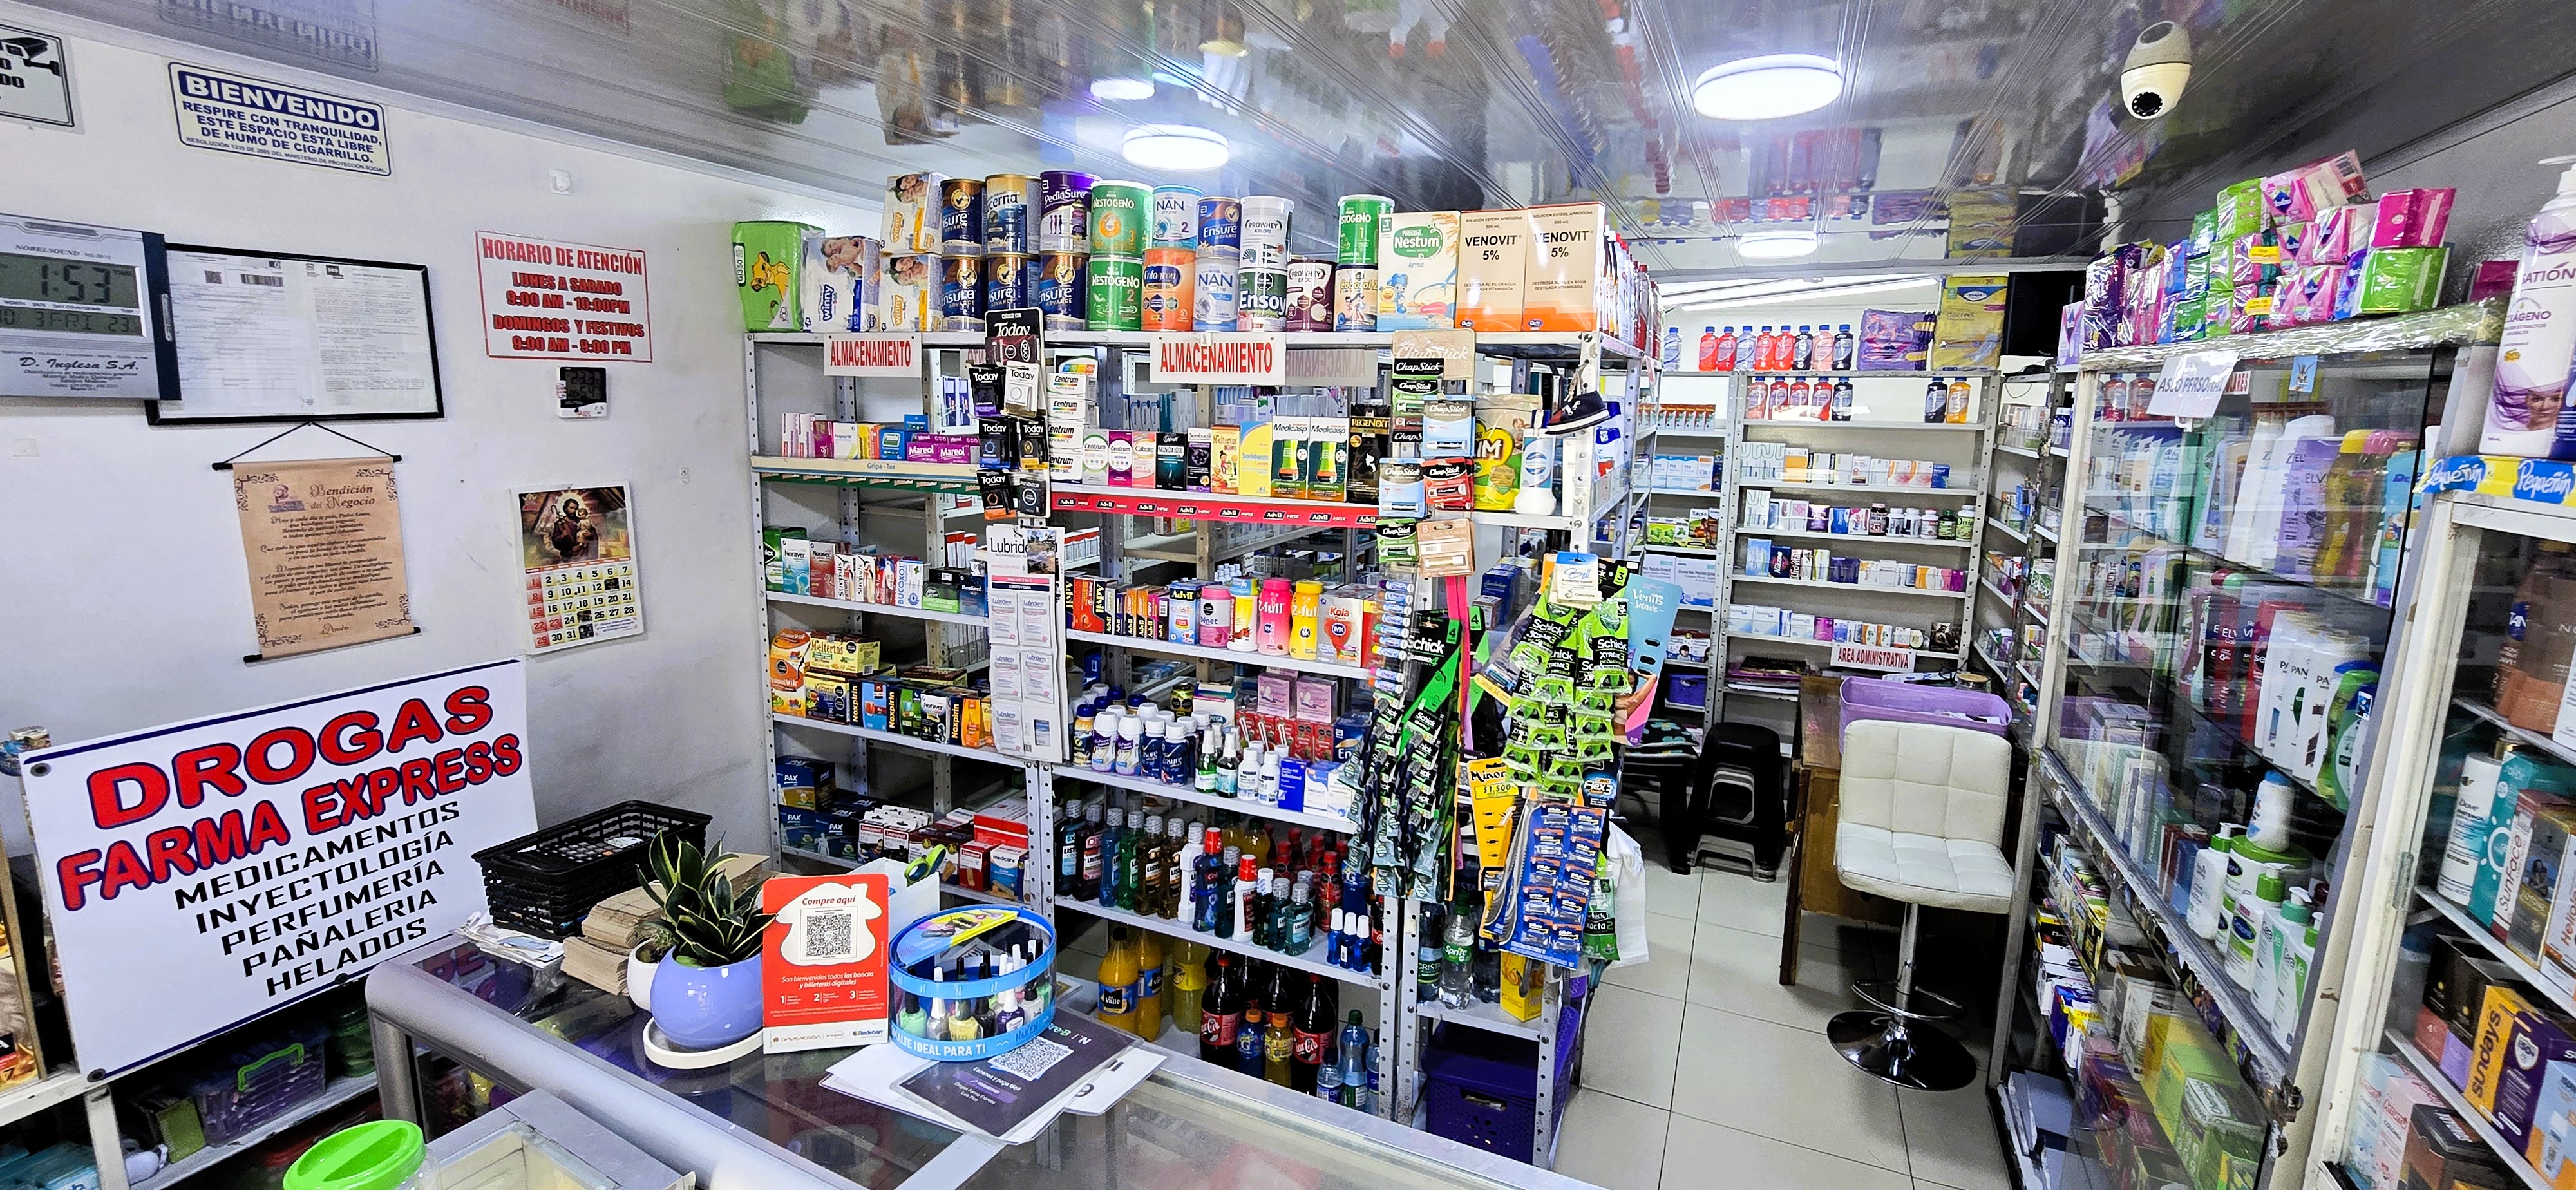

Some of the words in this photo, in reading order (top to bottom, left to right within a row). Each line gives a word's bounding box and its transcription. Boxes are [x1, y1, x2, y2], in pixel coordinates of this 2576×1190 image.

[185, 74, 375, 128] BIENVENIDO
[183, 100, 246, 120] RESPIRE
[250, 113, 279, 126] CON
[283, 119, 383, 146] TRANQUILIDAD,
[197, 115, 234, 129] ESTE
[239, 122, 298, 140] ESPACIO
[301, 132, 334, 147] ESTA
[337, 140, 374, 153] LIBRE
[201, 127, 221, 138] DE
[225, 131, 267, 146] HUMO
[272, 139, 290, 150] DE
[294, 142, 374, 163] CIGARRILLO.
[1045, 189, 1087, 204] PediaSure
[1094, 198, 1135, 209] NESTOGENO
[1156, 200, 1184, 211] NAN
[1180, 222, 1189, 233] 2
[1203, 225, 1237, 238] Ensure
[1394, 235, 1440, 249] Nestum
[1464, 234, 1518, 247] VENOVIT
[1533, 230, 1590, 243] VENOVIT
[15, 244, 80, 256] NOBELSOUND
[482, 237, 552, 265] HORARIO
[555, 247, 574, 268] DE
[577, 250, 643, 276] ATENCIÓN
[1482, 249, 1500, 260] 5%
[1551, 246, 1569, 258] 5%
[41, 263, 111, 303] 1:53
[511, 271, 556, 290] LUNES
[558, 276, 569, 291] A
[569, 278, 623, 296] SABADO
[1092, 274, 1140, 288] NESTOGENO
[1198, 273, 1233, 287] NAN
[506, 290, 540, 307] 9:00
[542, 294, 565, 310] AM
[822, 283, 834, 321] winny
[1239, 290, 1287, 316] Ensoy
[492, 314, 570, 334] DOMINGOS
[574, 319, 585, 334] Y
[586, 320, 645, 337] FESTIVOS
[994, 321, 1030, 337] Today
[512, 335, 545, 352] 9:00
[547, 337, 570, 353] AM
[579, 339, 610, 354] 9:00
[612, 340, 632, 355] PM
[830, 339, 912, 368] ALMACENAMIENTO
[1160, 341, 1273, 373] ALMACENAMIENTO
[19, 357, 40, 367] D.
[46, 358, 101, 371] Inglesa
[105, 359, 139, 370] S.A.
[1396, 361, 1440, 372] ChapStick
[972, 372, 998, 381] Today
[1010, 368, 1035, 381] Today
[1399, 382, 1432, 391] ChapStick
[1428, 404, 1466, 414] ChapStick
[982, 424, 1007, 433] Today
[1023, 424, 1044, 434] Today
[1047, 424, 1074, 435] Centrum
[1274, 422, 1308, 434] Medicasp
[1311, 424, 1347, 435] Medicasp
[909, 444, 934, 456] Mareol
[940, 446, 965, 457] Mareol
[1242, 453, 1269, 461] Soriderm
[1384, 468, 1421, 477] ChapStick
[1429, 466, 1461, 477] ChapStick
[980, 475, 1006, 485] Today
[310, 484, 374, 498] Bendición
[310, 501, 322, 510] del
[325, 495, 375, 511] Negocio
[1382, 526, 1412, 535] ChapStick
[1095, 583, 1105, 613] Advil
[1171, 590, 1194, 600] Advil
[1632, 587, 1664, 606] Venus
[531, 607, 542, 616] 15
[547, 604, 558, 613] 16
[563, 601, 573, 610] 17
[579, 599, 589, 608] 18
[594, 597, 603, 606] 19
[607, 594, 618, 603] 20
[622, 592, 632, 601] 21
[1329, 605, 1350, 617] Kola
[534, 621, 545, 630] 22
[549, 619, 560, 628] 23
[564, 616, 575, 625] 24
[594, 610, 605, 619] 26
[609, 608, 620, 617] 27
[623, 606, 634, 614] 28
[1532, 618, 1564, 637] Schick
[536, 635, 548, 645] 29
[551, 633, 563, 642] 30
[566, 630, 576, 639] 31
[1597, 638, 1627, 650] Schick
[1837, 647, 1855, 663] AREA
[1856, 648, 1909, 669] ADMINISTRATIVA
[951, 703, 960, 739] Noxpirin
[86, 685, 495, 831] DROGAS
[1471, 770, 1506, 782] Minor
[55, 800, 291, 912] FARMA
[301, 733, 523, 836] EXPRESS
[174, 800, 460, 910] MEDICAMENTOS
[992, 855, 1015, 864] medicare
[195, 829, 455, 934] INYECTOLOGÍA
[220, 858, 446, 956] PERFUMERÍA
[802, 897, 835, 907] Compre
[837, 895, 857, 905] aquí
[242, 888, 438, 978] PAÑALERIA
[265, 917, 427, 997] HELADOS
[1444, 945, 1468, 957] Sprite
[793, 974, 827, 983] bienvenidos
[831, 979, 857, 988] digitales
[1104, 996, 1121, 1005] Valle
[914, 1041, 941, 1056] IDEAL
[943, 1044, 973, 1057] PARA
[975, 1043, 987, 1055] TI
[2470, 1009, 2501, 1099] sundays
